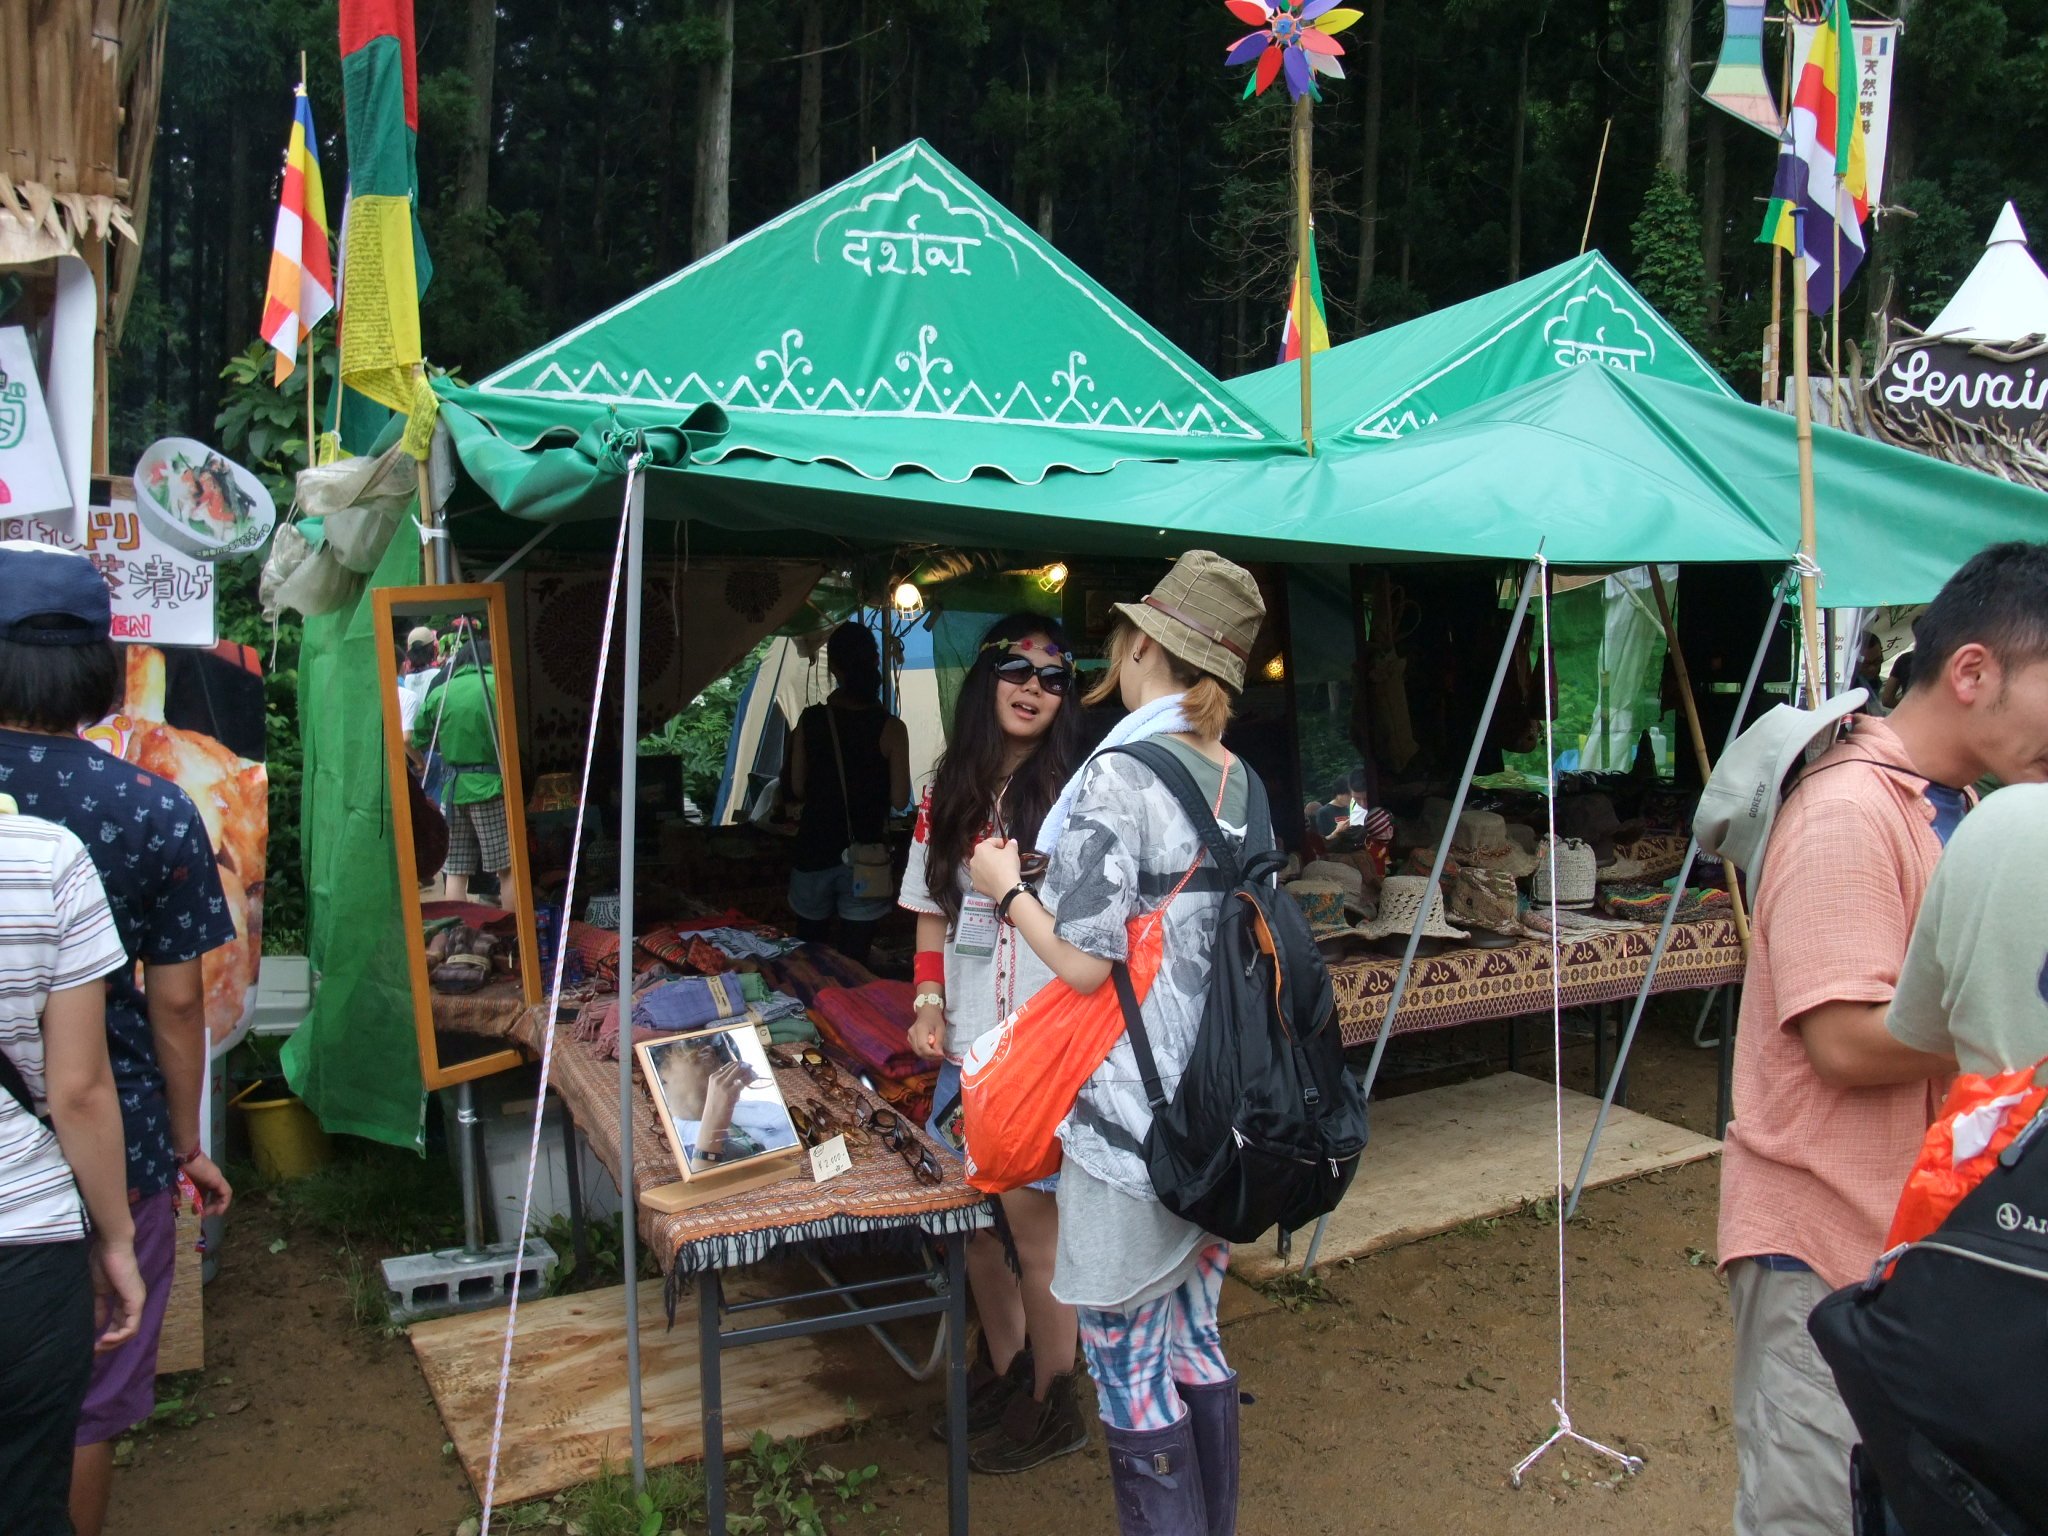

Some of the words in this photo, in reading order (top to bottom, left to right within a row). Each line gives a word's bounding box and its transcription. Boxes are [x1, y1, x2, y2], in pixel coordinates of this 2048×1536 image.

[1884, 350, 2048, 410] Levai
[1749, 781, 1767, 818] GORE-TEX
[2023, 1215, 2048, 1235] AI
